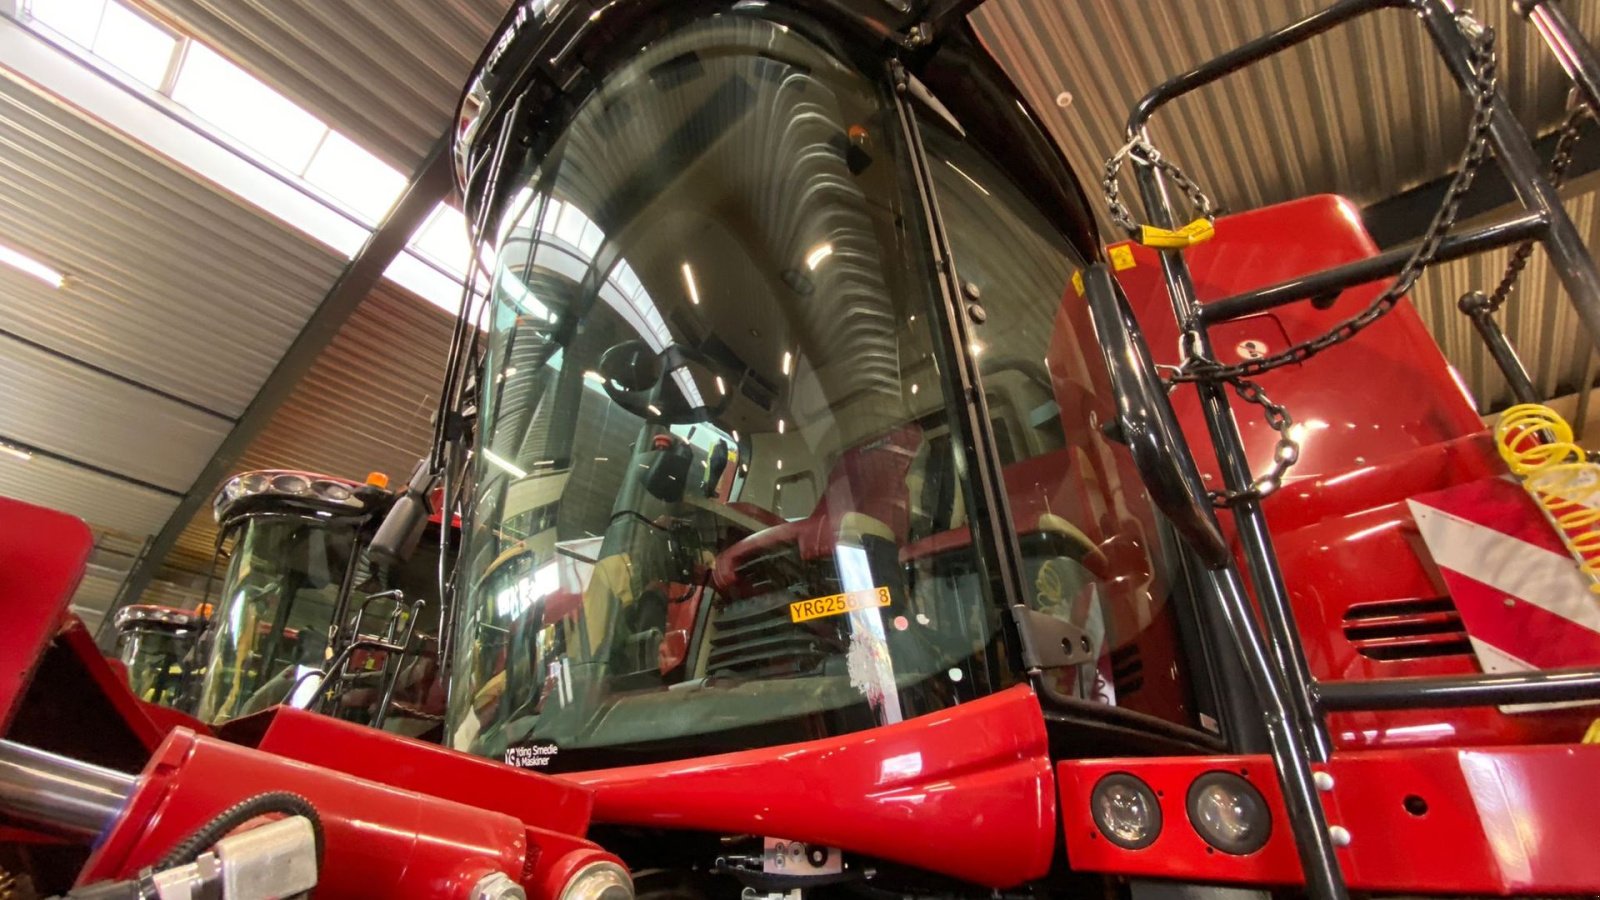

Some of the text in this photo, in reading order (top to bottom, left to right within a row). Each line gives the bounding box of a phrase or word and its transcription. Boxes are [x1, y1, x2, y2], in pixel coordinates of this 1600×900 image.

[792, 588, 890, 619] YRG2568
[516, 744, 558, 757] Yding Smedie
[516, 756, 550, 767] & Maskiner
